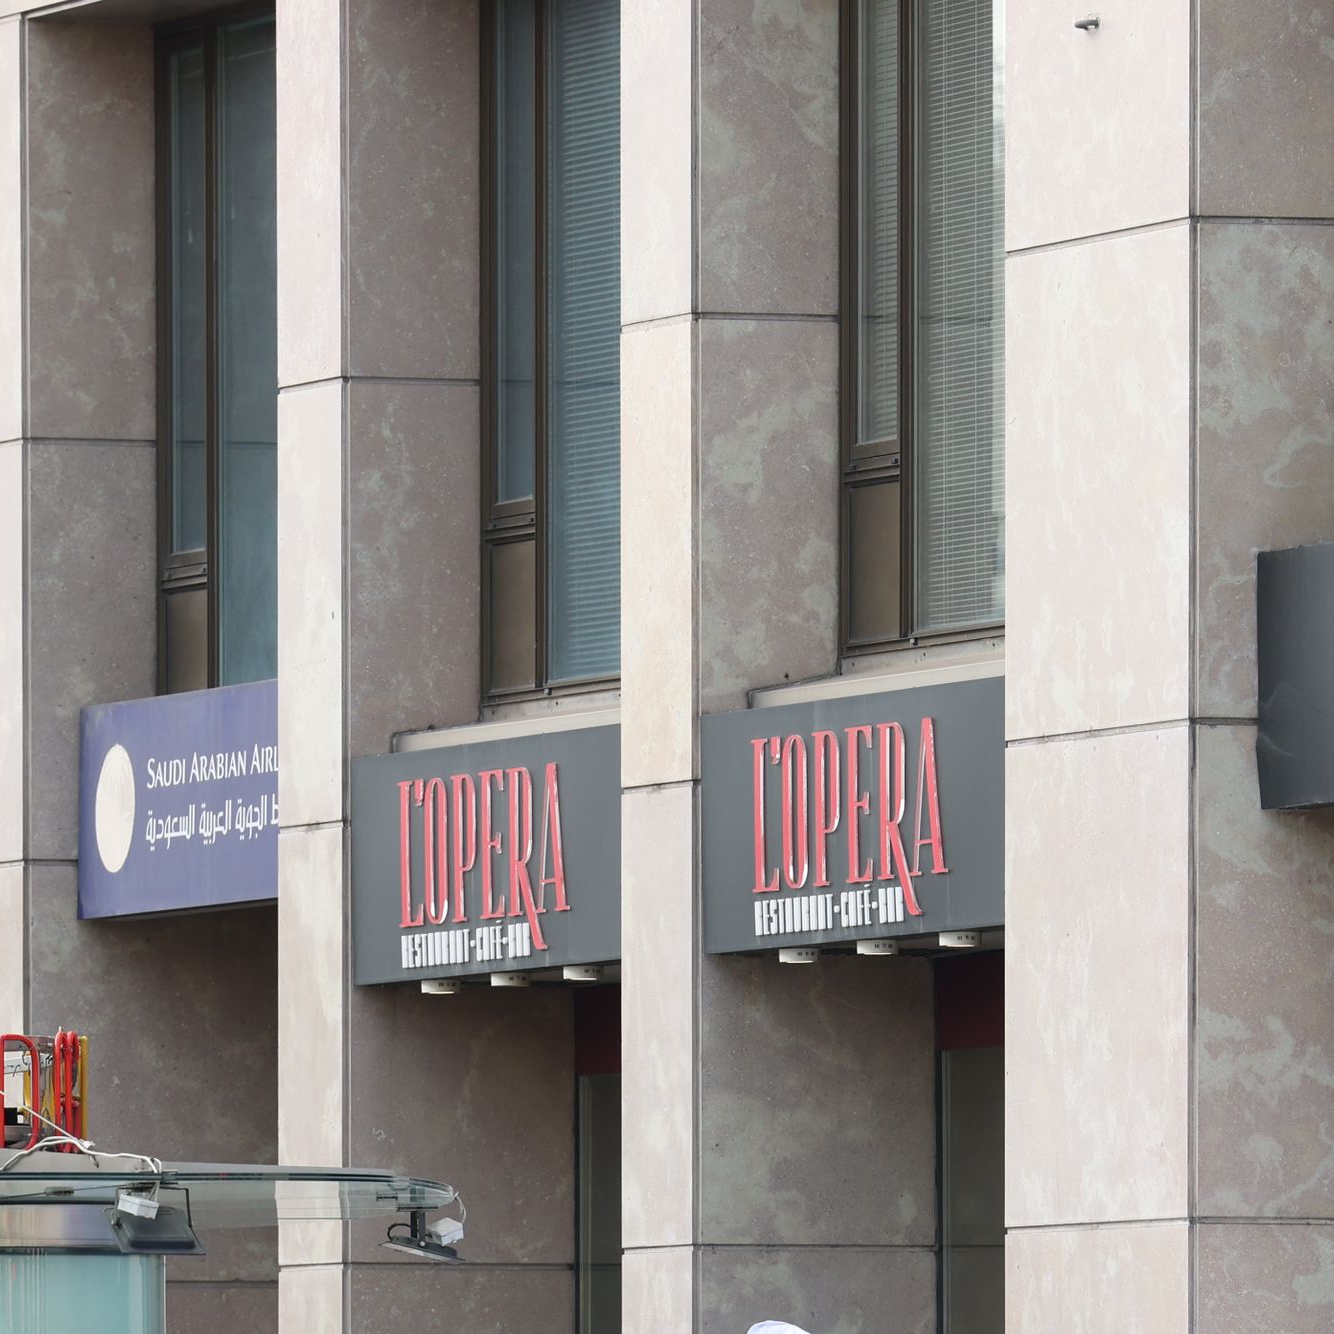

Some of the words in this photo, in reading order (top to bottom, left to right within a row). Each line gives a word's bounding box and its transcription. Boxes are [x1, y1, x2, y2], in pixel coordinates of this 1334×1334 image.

[147, 758, 186, 789] SAUDI
[189, 752, 247, 783] ARABIAN
[397, 761, 571, 950] L'OPERA
[750, 716, 949, 916] L'OPERA
